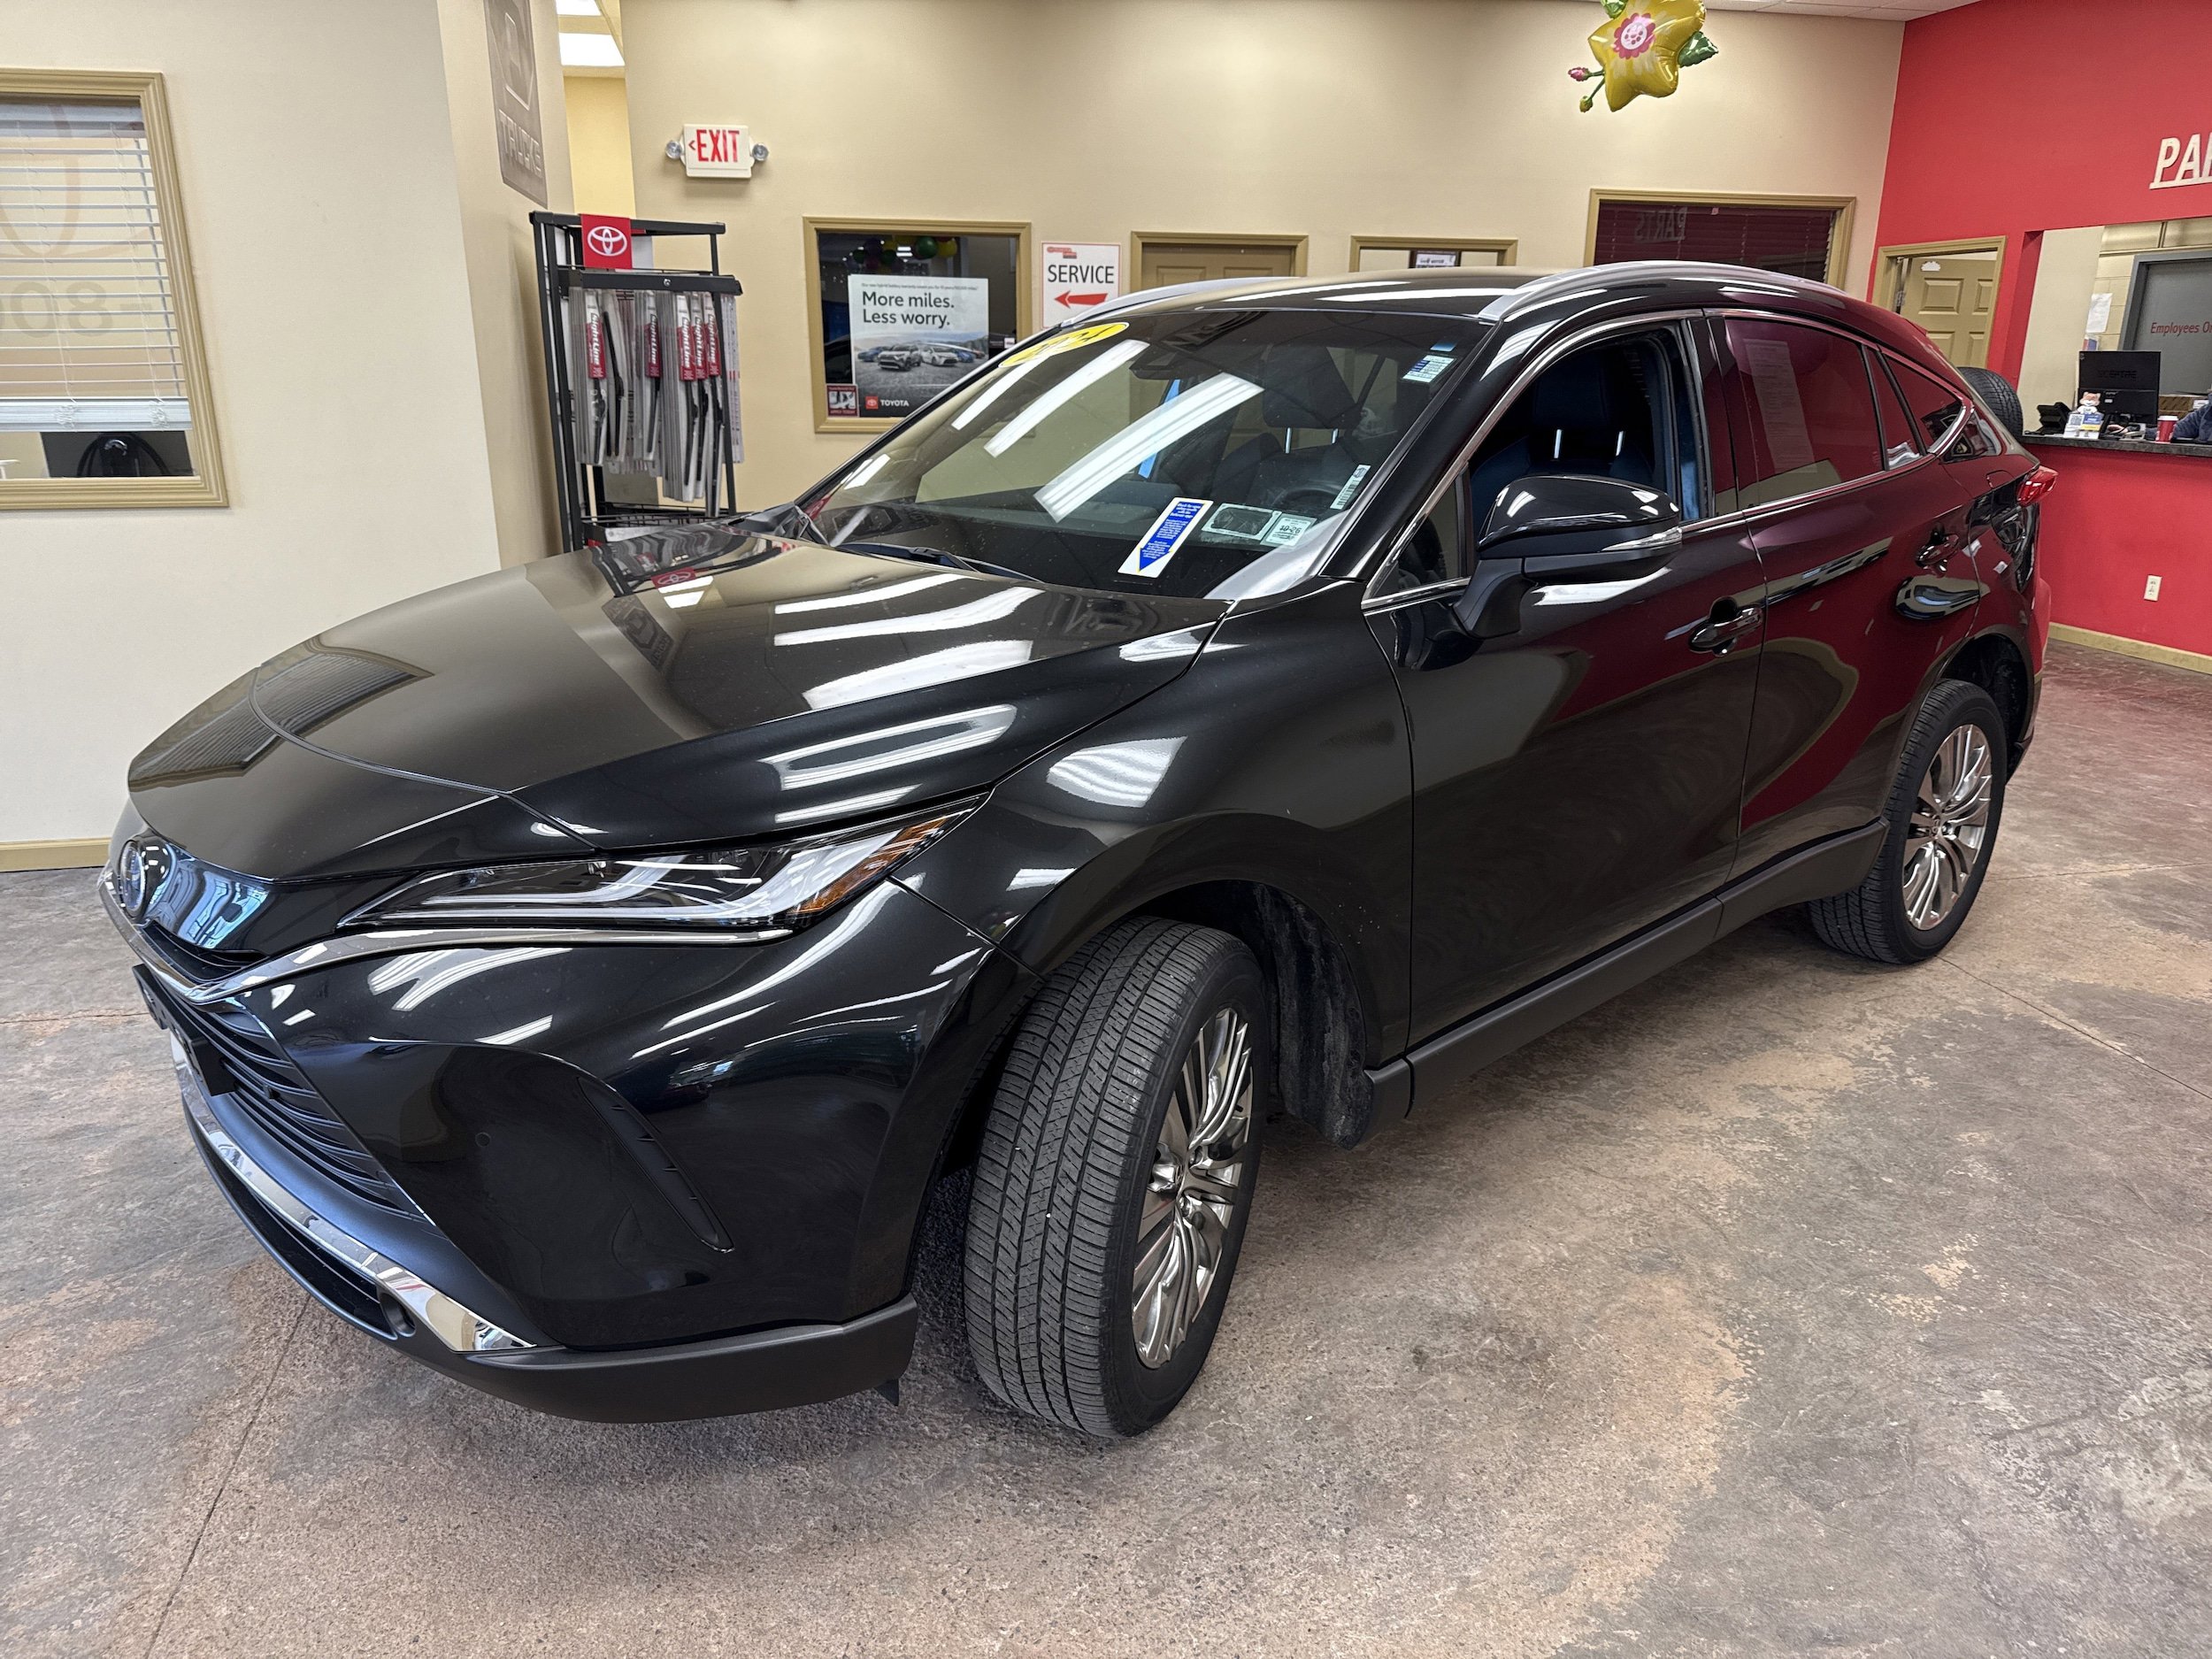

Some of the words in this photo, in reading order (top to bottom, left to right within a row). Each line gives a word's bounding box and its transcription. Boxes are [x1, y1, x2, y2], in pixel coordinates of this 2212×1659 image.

[696, 129, 740, 163] EXIT
[1048, 264, 1114, 284] SERVICE
[862, 291, 903, 307] More
[909, 293, 955, 309] miles.
[863, 308, 897, 324] Less
[901, 312, 950, 328] worry.
[2150, 322, 2200, 336] Employees
[2202, 320, 2212, 334] O
